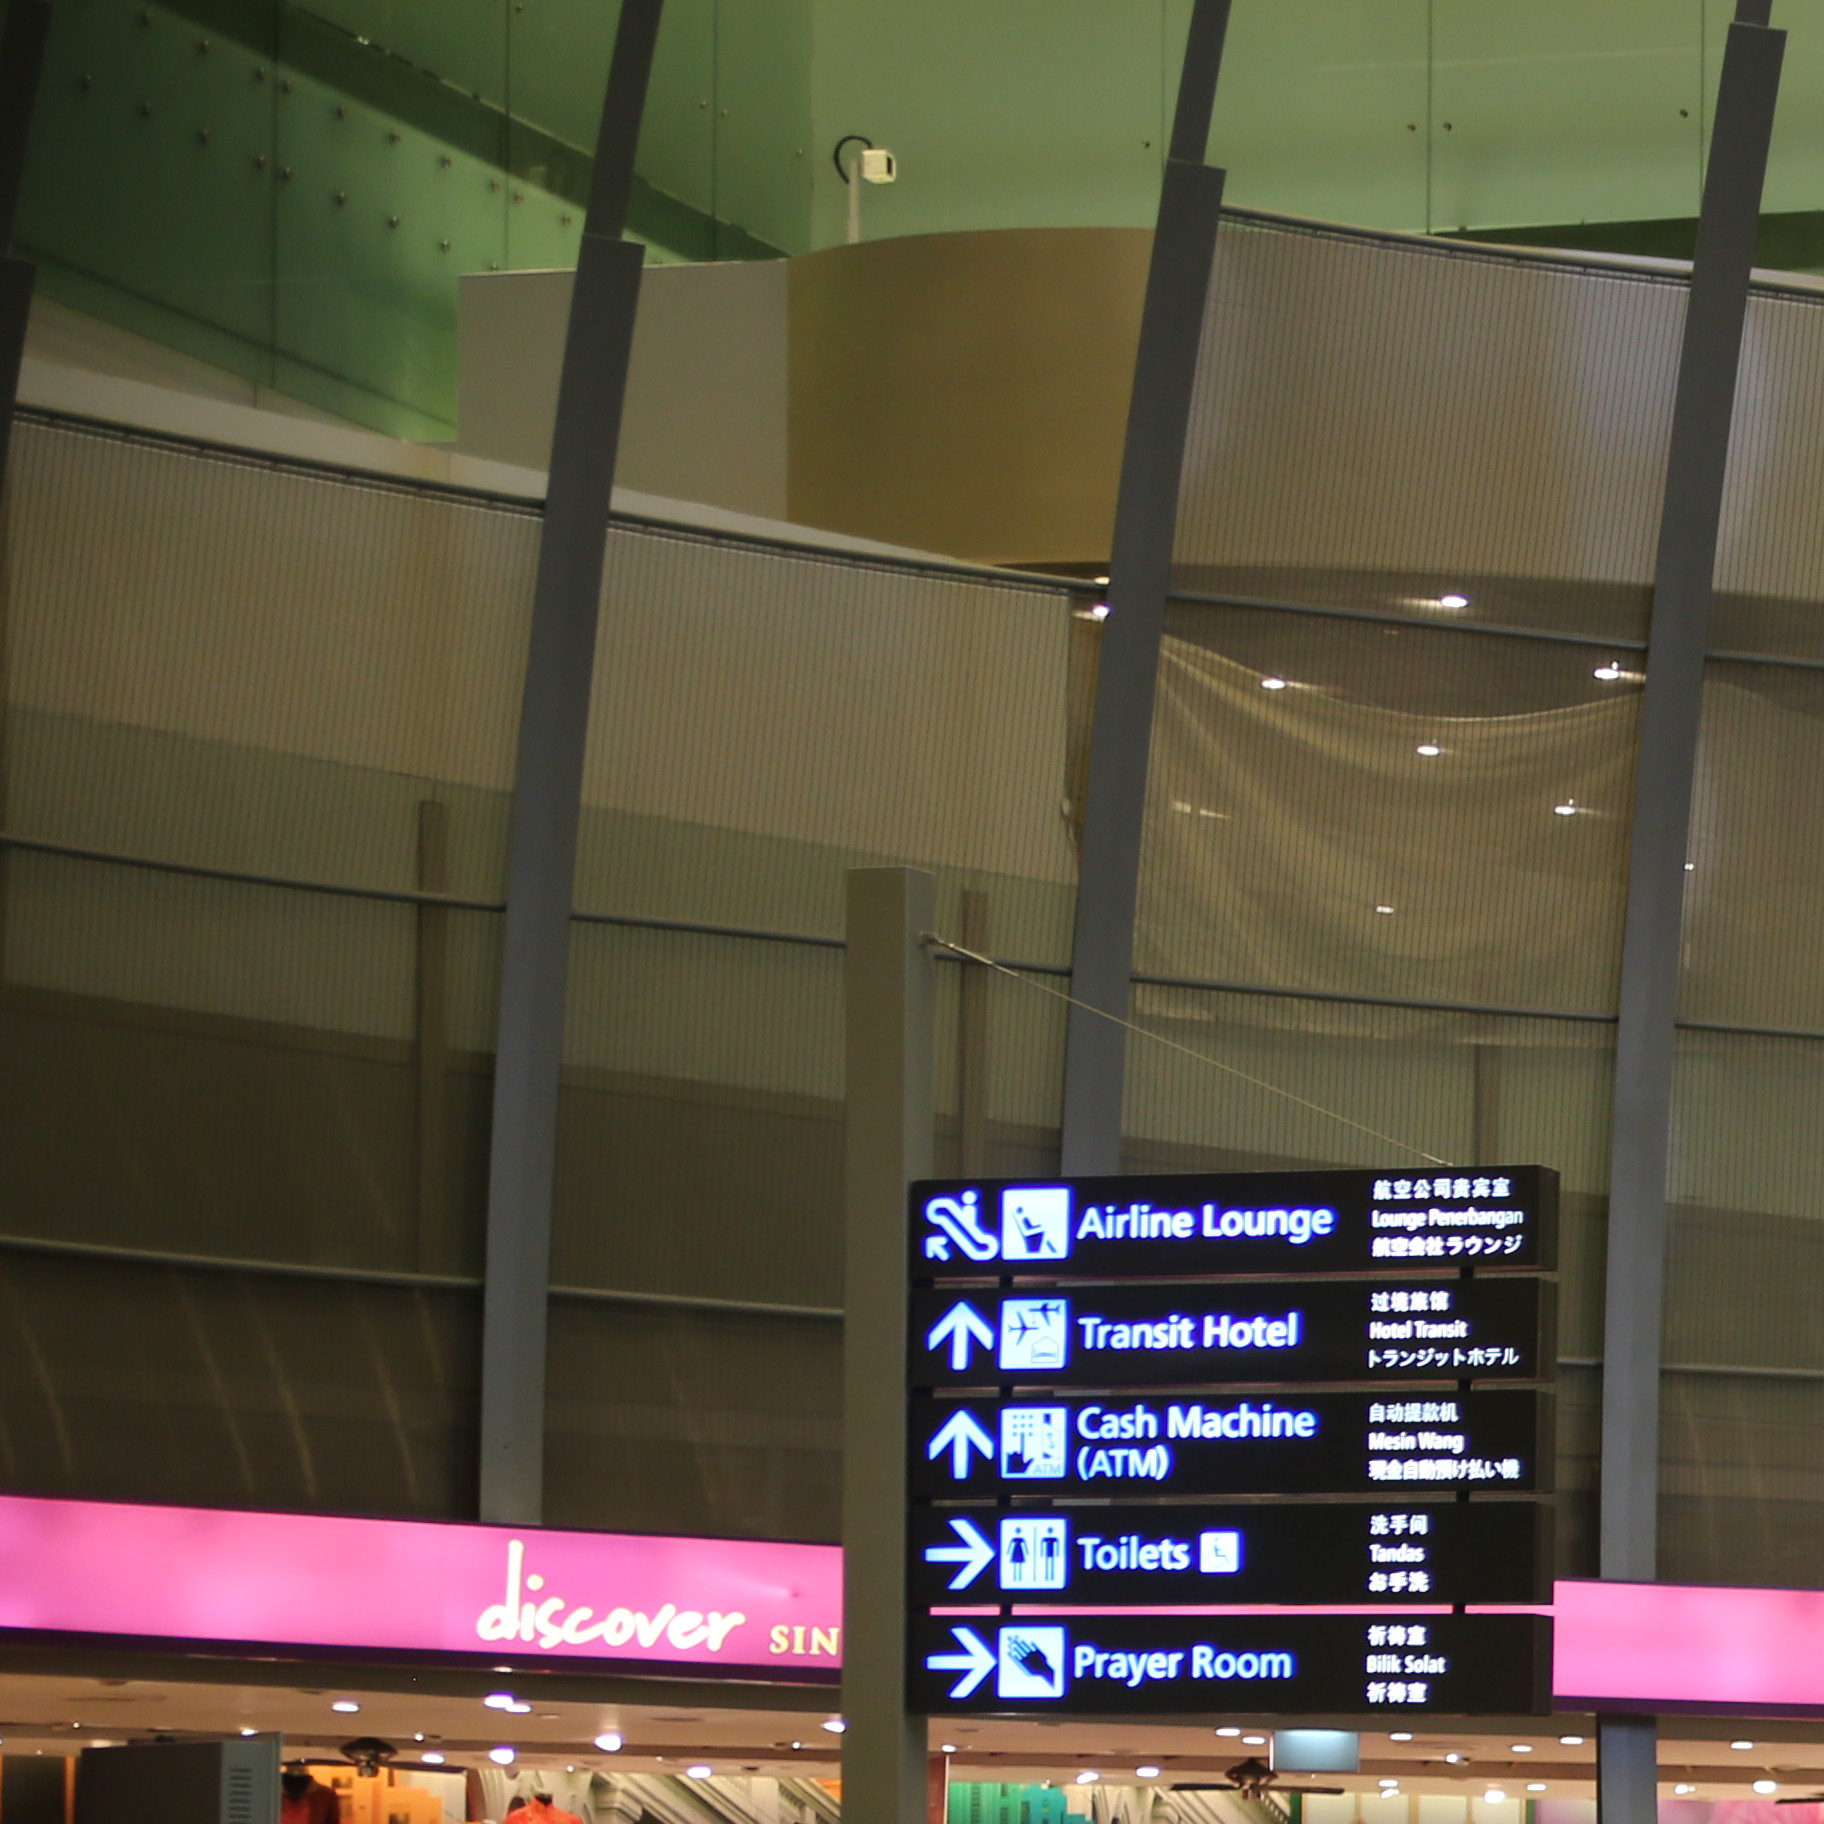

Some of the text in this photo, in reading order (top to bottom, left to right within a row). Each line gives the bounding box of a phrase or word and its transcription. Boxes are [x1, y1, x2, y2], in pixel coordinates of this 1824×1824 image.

[1373, 1177, 1510, 1200] 航空公司贵宾室
[1076, 1204, 1334, 1244] Airline Lounge
[1371, 1207, 1523, 1231] Lounge Penerbangan
[1372, 1234, 1523, 1257] 航空会社ラウンジ
[1077, 1311, 1299, 1349] Transit Hotel
[1369, 1319, 1469, 1339] Hotel Transit
[1368, 1347, 1520, 1368] トランジットホテル
[1077, 1403, 1316, 1440] Cash Machine
[1369, 1402, 1459, 1423] 自动提款机
[1368, 1432, 1465, 1454] Mesin Wang
[1077, 1445, 1170, 1481] (ATM)
[1370, 1514, 1429, 1535] 洗手间
[1076, 1535, 1190, 1570] Toilets
[1369, 1543, 1425, 1562] Tandas
[1368, 1571, 1430, 1592] お手洗
[476, 1538, 746, 1652] discover
[1074, 1645, 1292, 1688] Prayer Room
[1366, 1654, 1447, 1674] Bilik Solat
